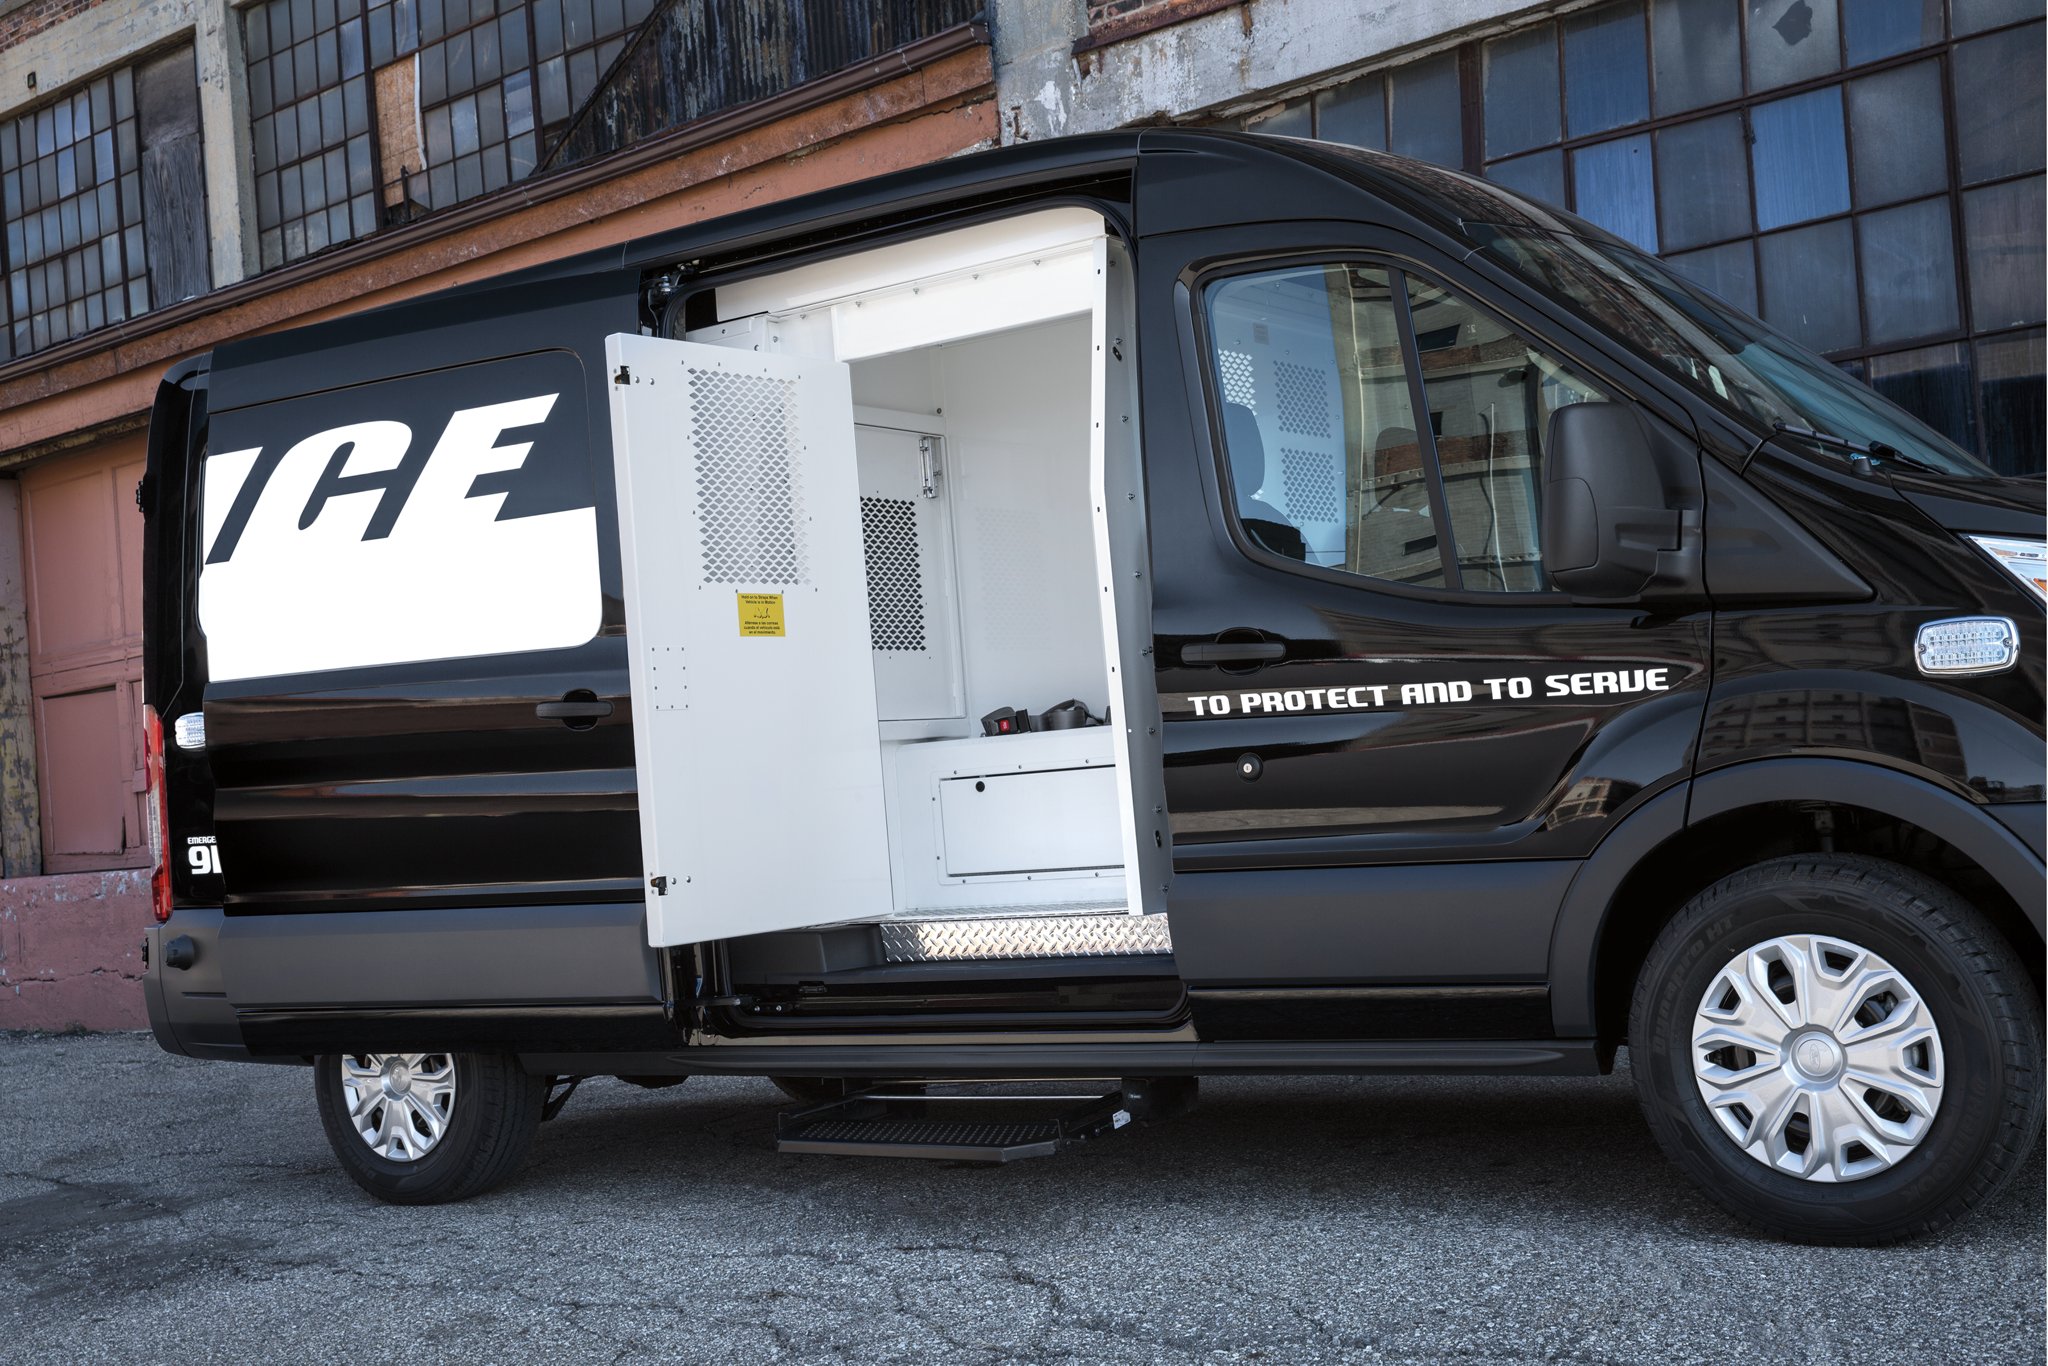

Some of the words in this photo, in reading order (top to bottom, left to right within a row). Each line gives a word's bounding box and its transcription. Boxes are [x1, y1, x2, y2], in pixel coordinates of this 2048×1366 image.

[1188, 695, 1231, 716] TO
[1239, 685, 1389, 714] PROTECT
[1400, 681, 1473, 705] AND
[1483, 677, 1533, 700] TO
[1545, 668, 1670, 697] SERVE
